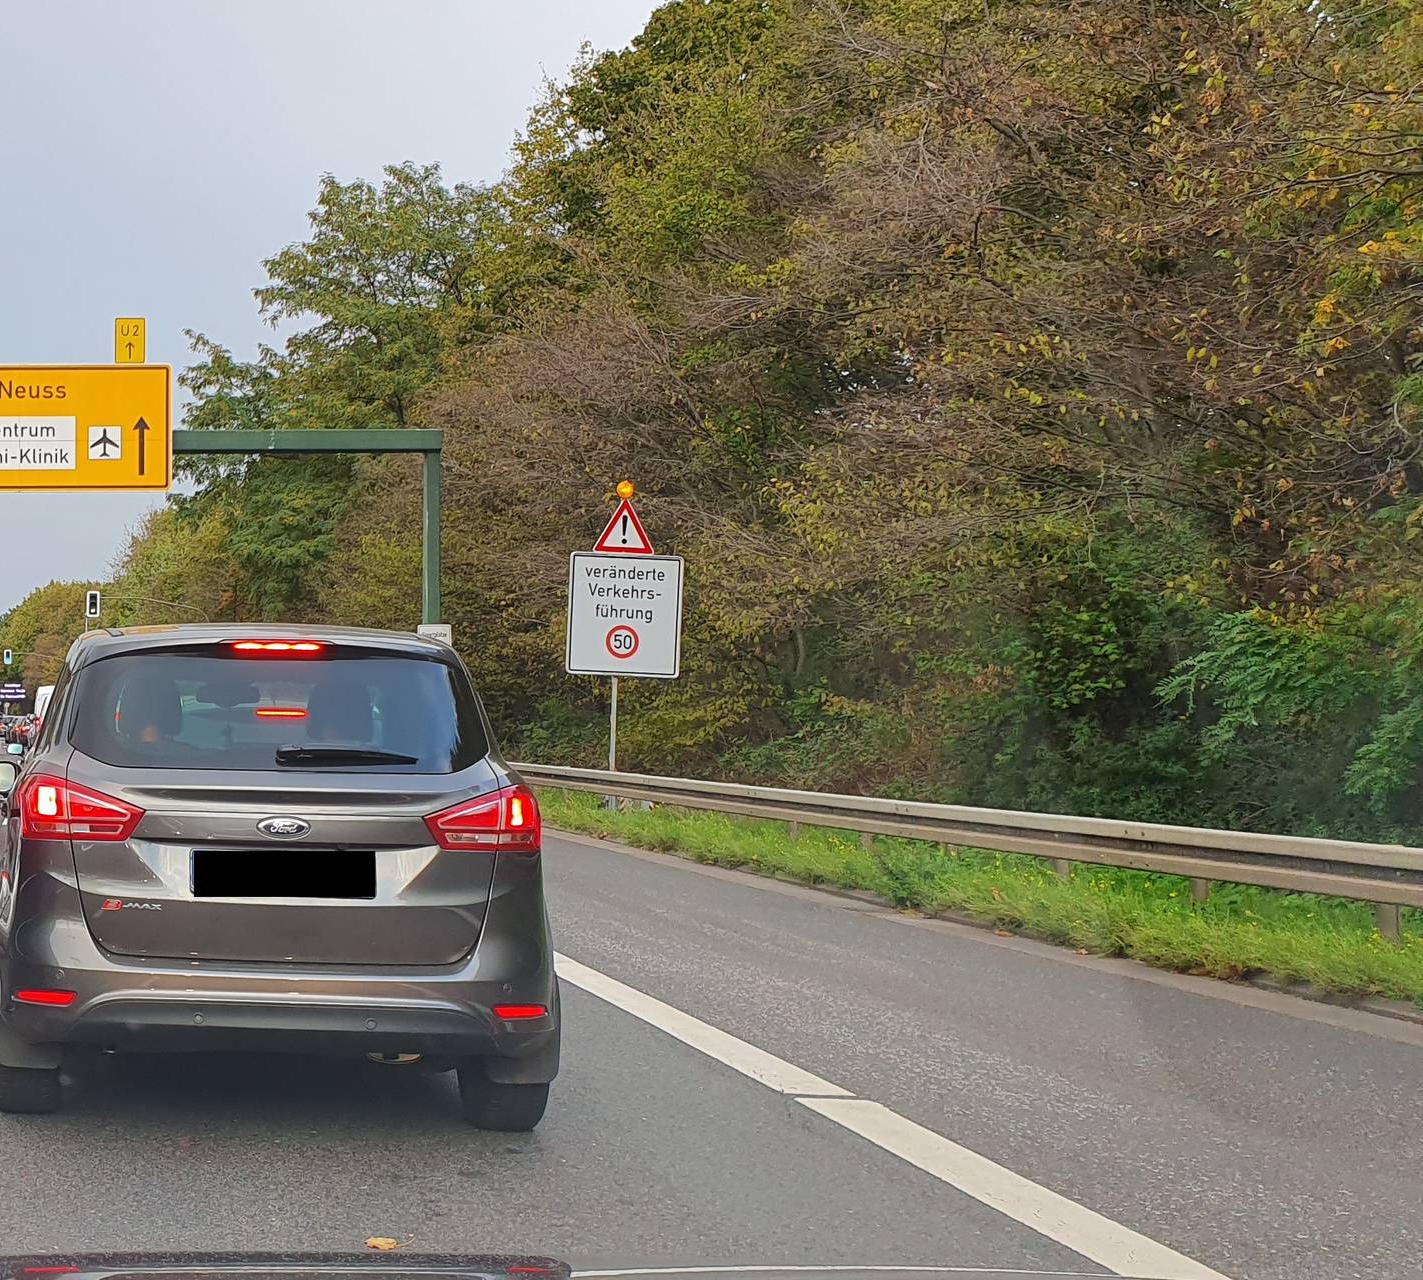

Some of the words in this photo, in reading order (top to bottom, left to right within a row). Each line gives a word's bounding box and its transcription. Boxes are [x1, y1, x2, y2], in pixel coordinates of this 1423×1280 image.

[585, 565, 665, 581] veränderte
[588, 583, 662, 600] Verkehrs-
[595, 604, 653, 624] führung
[613, 634, 632, 650] 50
[268, 819, 300, 834] Ford
